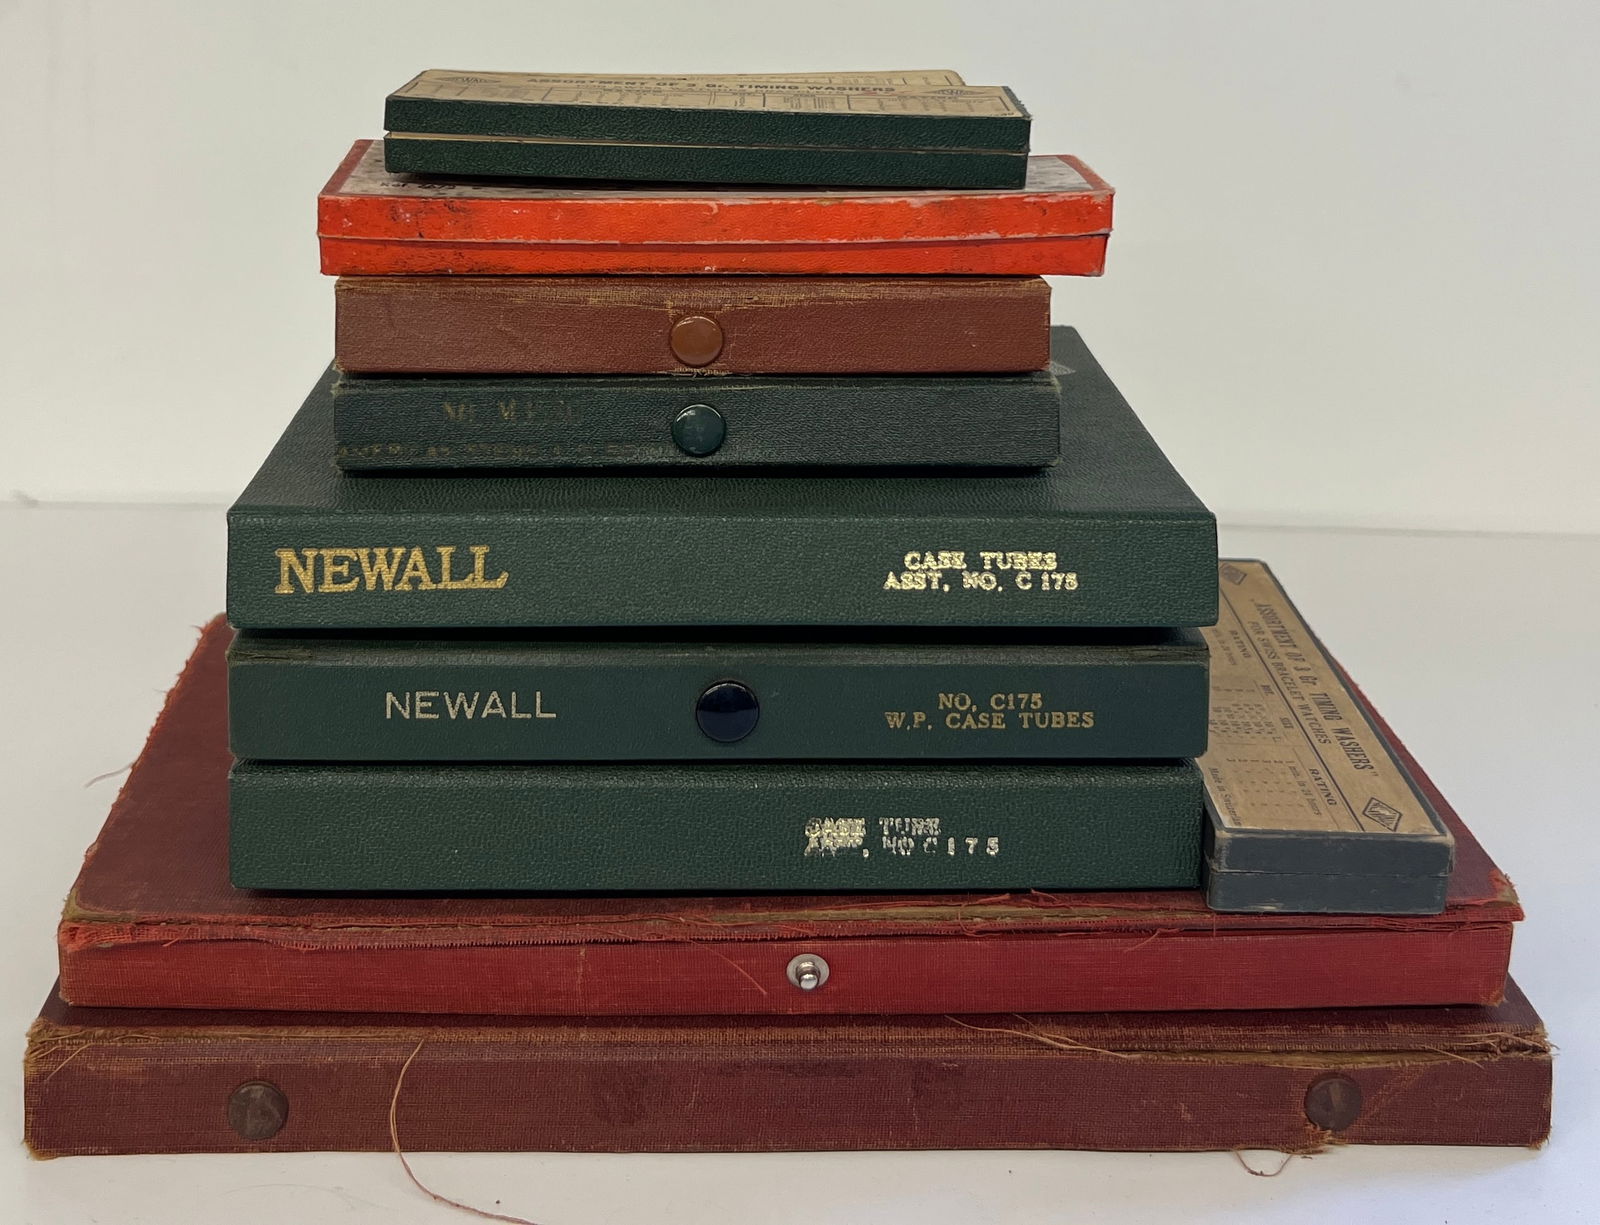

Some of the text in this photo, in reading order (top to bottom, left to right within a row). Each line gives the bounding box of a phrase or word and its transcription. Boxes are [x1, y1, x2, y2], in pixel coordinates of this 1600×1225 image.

[527, 78, 647, 87] ASSORTMENT
[808, 85, 896, 93] WASHERS
[274, 545, 509, 594] NEWALL
[904, 551, 1058, 570] CASE TUBES
[962, 570, 1003, 592] NO.
[1015, 572, 1033, 590] C
[1041, 571, 1078, 591] 175
[1247, 621, 1266, 636] FOR
[1255, 636, 1281, 659] SWISS
[1271, 662, 1305, 700] BRACELET
[1286, 652, 1306, 662] OF
[1309, 692, 1341, 720] TIMING
[386, 691, 557, 719] NEWALL
[990, 693, 1043, 710] C175
[945, 712, 1006, 729] CASE
[1018, 711, 1095, 729] TUBES
[1295, 702, 1331, 744] WATCHES
[1308, 768, 1337, 806] RATING
